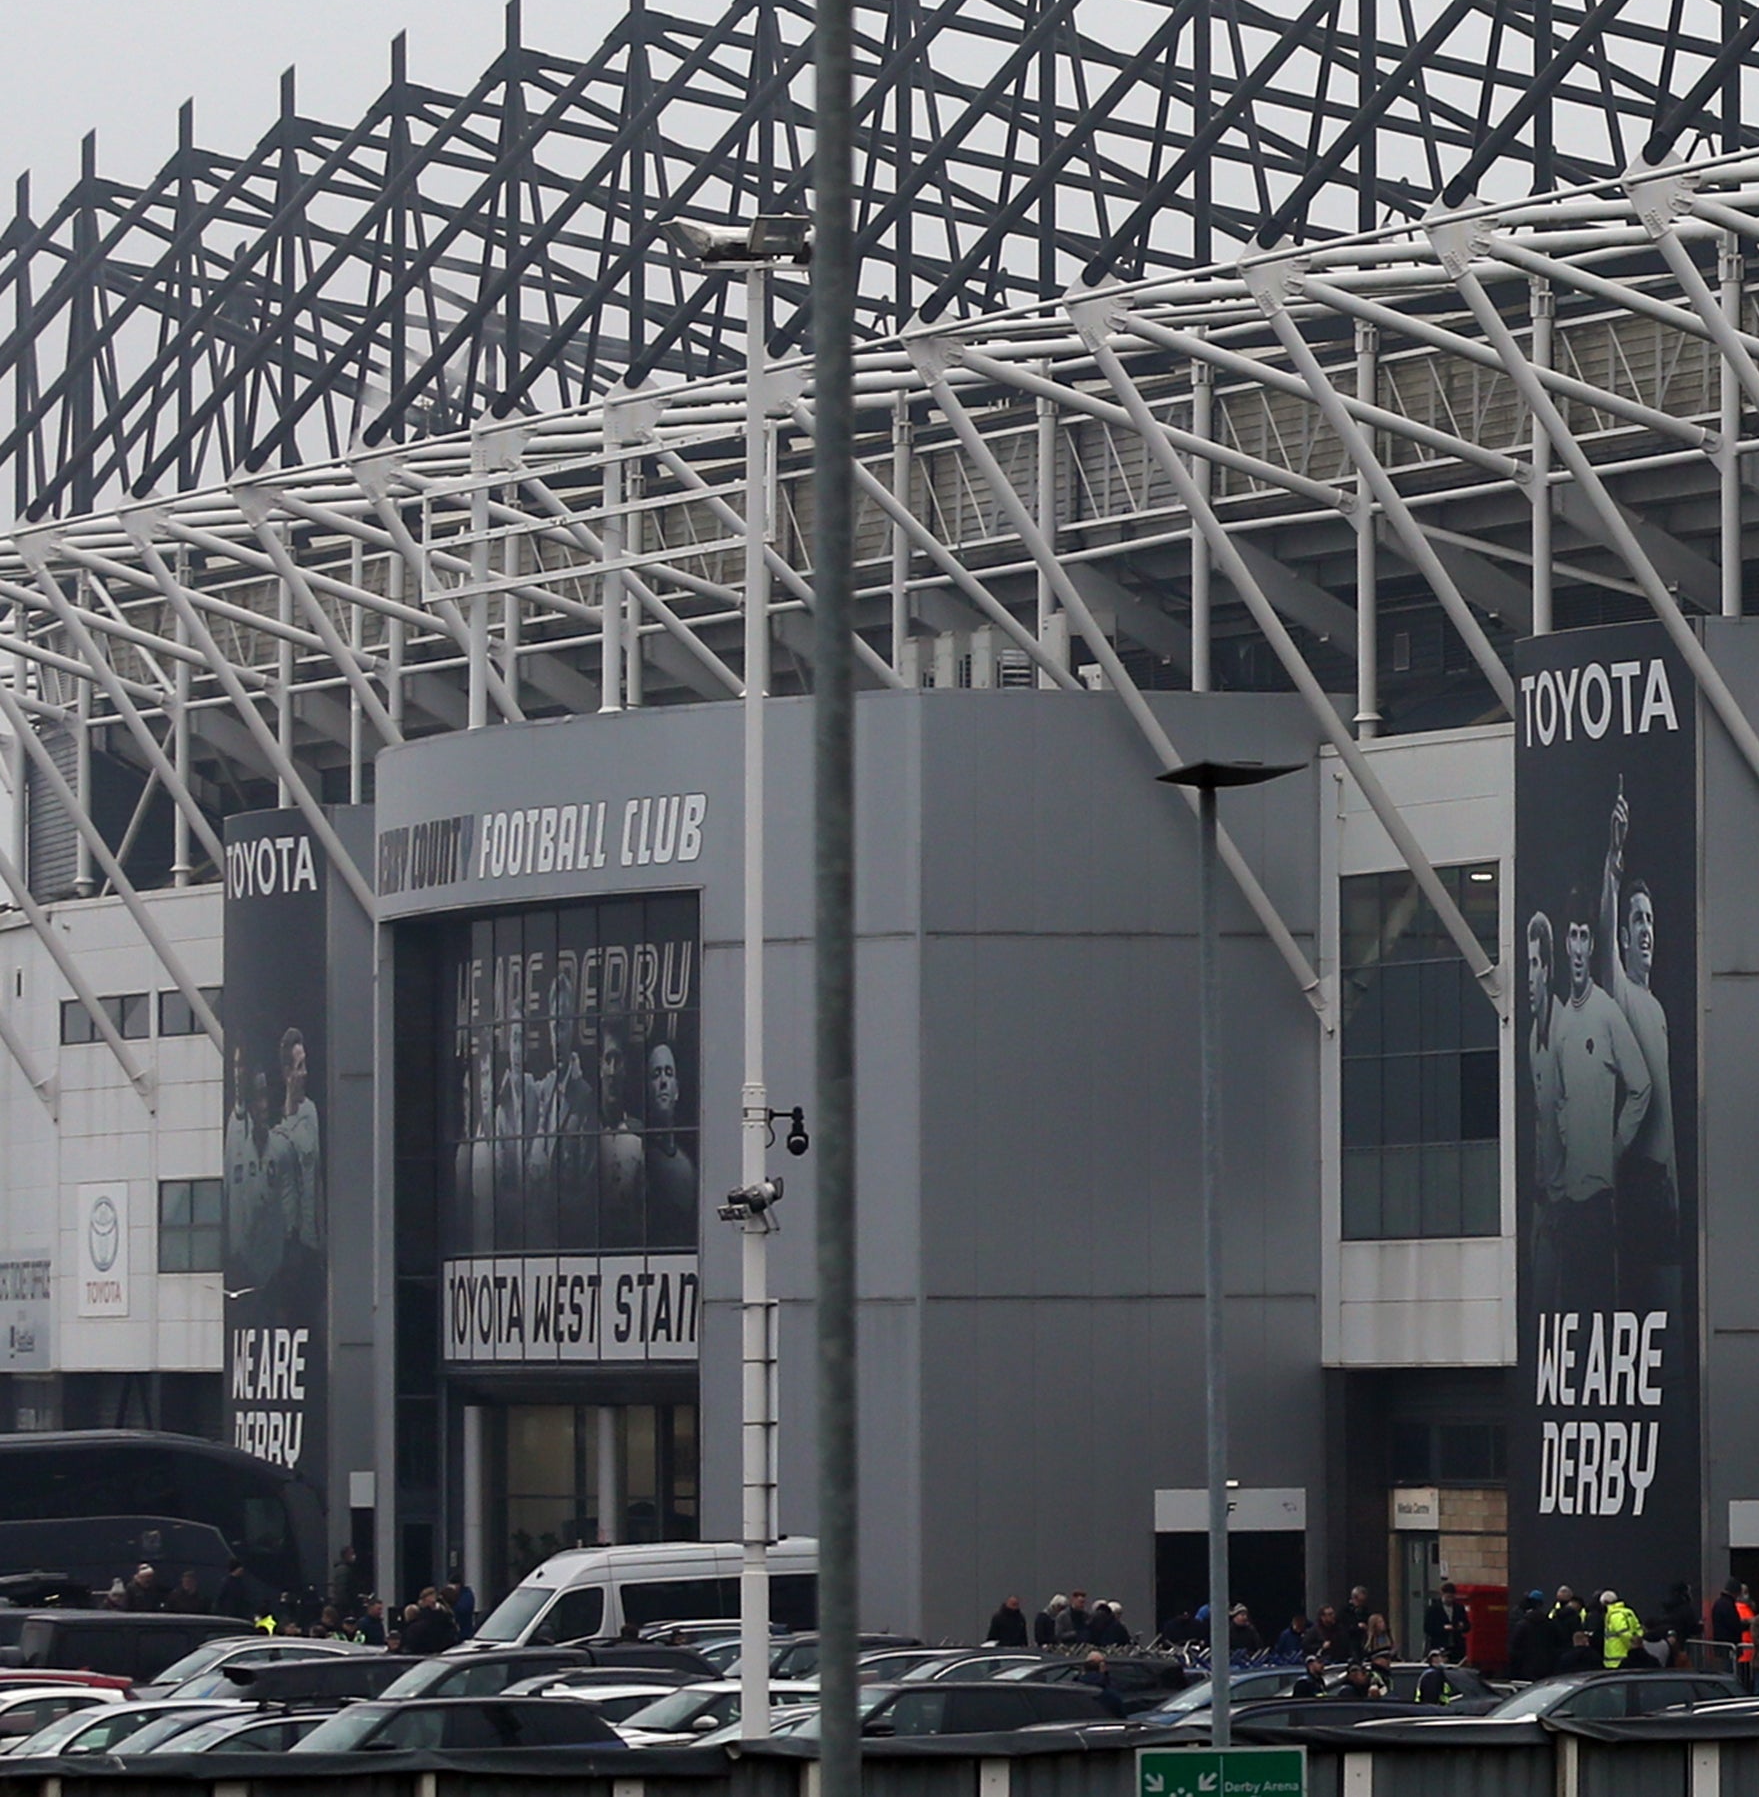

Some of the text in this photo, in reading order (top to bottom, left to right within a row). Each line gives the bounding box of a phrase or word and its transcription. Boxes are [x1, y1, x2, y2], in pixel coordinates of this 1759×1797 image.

[1521, 658, 1679, 747] TOYOTA
[226, 836, 317, 900] TOYOTA
[479, 803, 607, 880] FOOTBALL
[621, 794, 707, 867] CLUB
[86, 1280, 122, 1304] TOYOTA
[450, 1274, 524, 1345] TOYOTA
[533, 1274, 602, 1344] WEST
[232, 1328, 309, 1400] WE ARE
[1536, 1311, 1668, 1407] WE ARE
[1539, 1421, 1660, 1517] DERBY
[1225, 1502, 1238, 1517] F
[1224, 1780, 1299, 1794] Derby Arena
